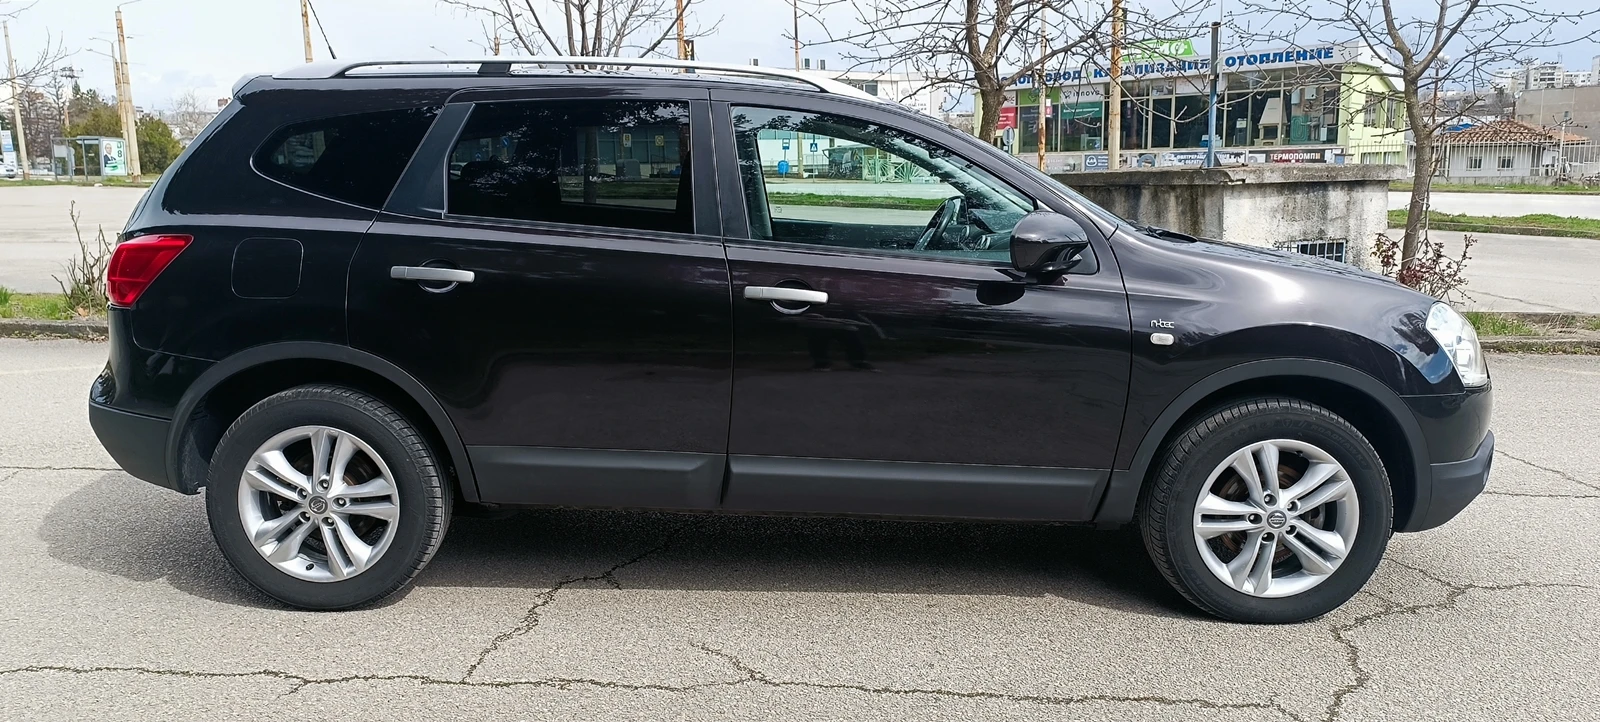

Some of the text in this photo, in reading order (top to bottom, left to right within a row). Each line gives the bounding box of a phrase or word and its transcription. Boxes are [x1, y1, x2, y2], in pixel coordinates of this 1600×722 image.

[1093, 59, 1210, 78] КААЛИЗАЦИЯ
[1225, 47, 1334, 68] ОТОПЛЕНИЕ
[1269, 152, 1321, 160] ТЕРМОПОМПИ
